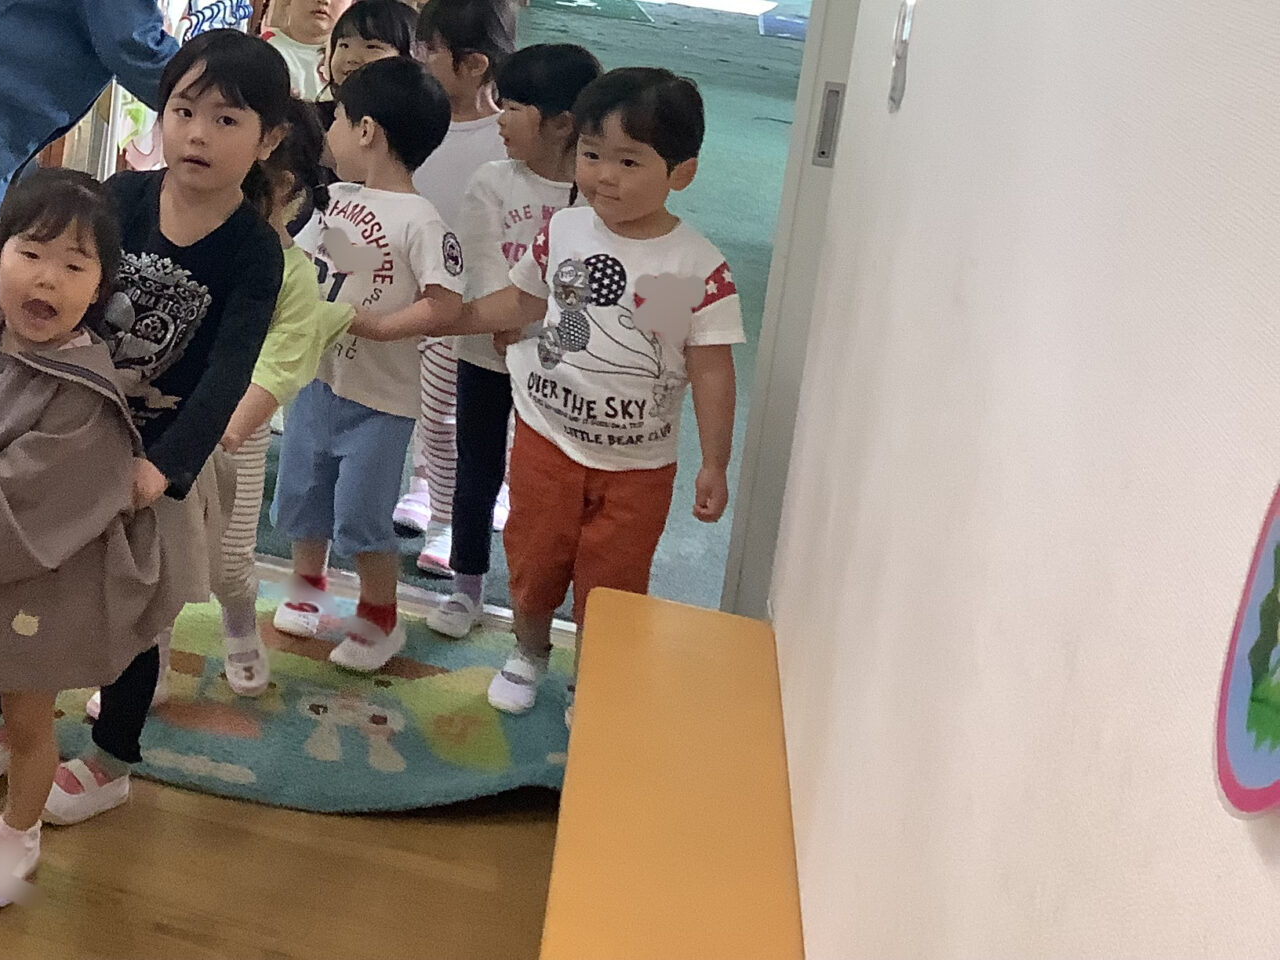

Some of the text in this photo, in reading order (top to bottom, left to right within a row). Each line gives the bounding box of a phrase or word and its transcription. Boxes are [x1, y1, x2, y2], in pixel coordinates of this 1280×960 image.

[527, 371, 559, 400] OVER
[562, 386, 597, 420] THE
[604, 396, 646, 421] SKY
[563, 425, 603, 445] LITTLE
[607, 434, 644, 447] BEAR
